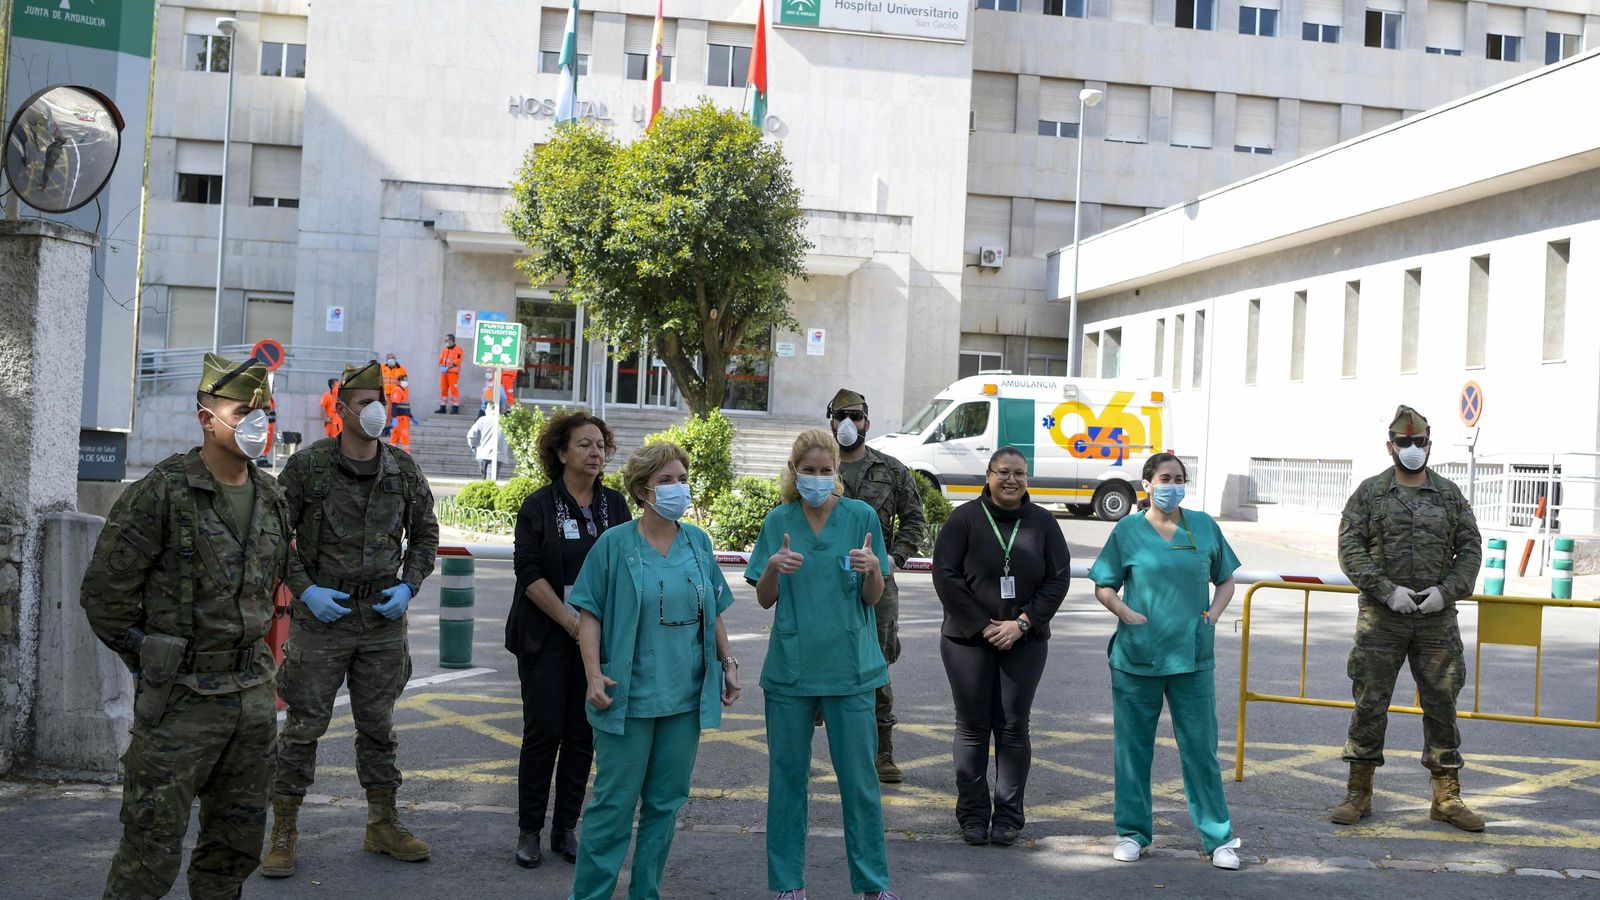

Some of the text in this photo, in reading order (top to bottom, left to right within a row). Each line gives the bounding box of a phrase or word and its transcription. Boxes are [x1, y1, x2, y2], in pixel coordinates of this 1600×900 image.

[24, 6, 106, 27] JUNTA DE ANDALUCIA
[835, 0, 959, 20] Hospital Universitario
[914, 18, 958, 30] San Cecilio
[508, 95, 612, 120] HOSTAL
[1001, 380, 1057, 389] AMBULANCIA
[85, 454, 94, 462] DE
[95, 454, 116, 463] SALUD
